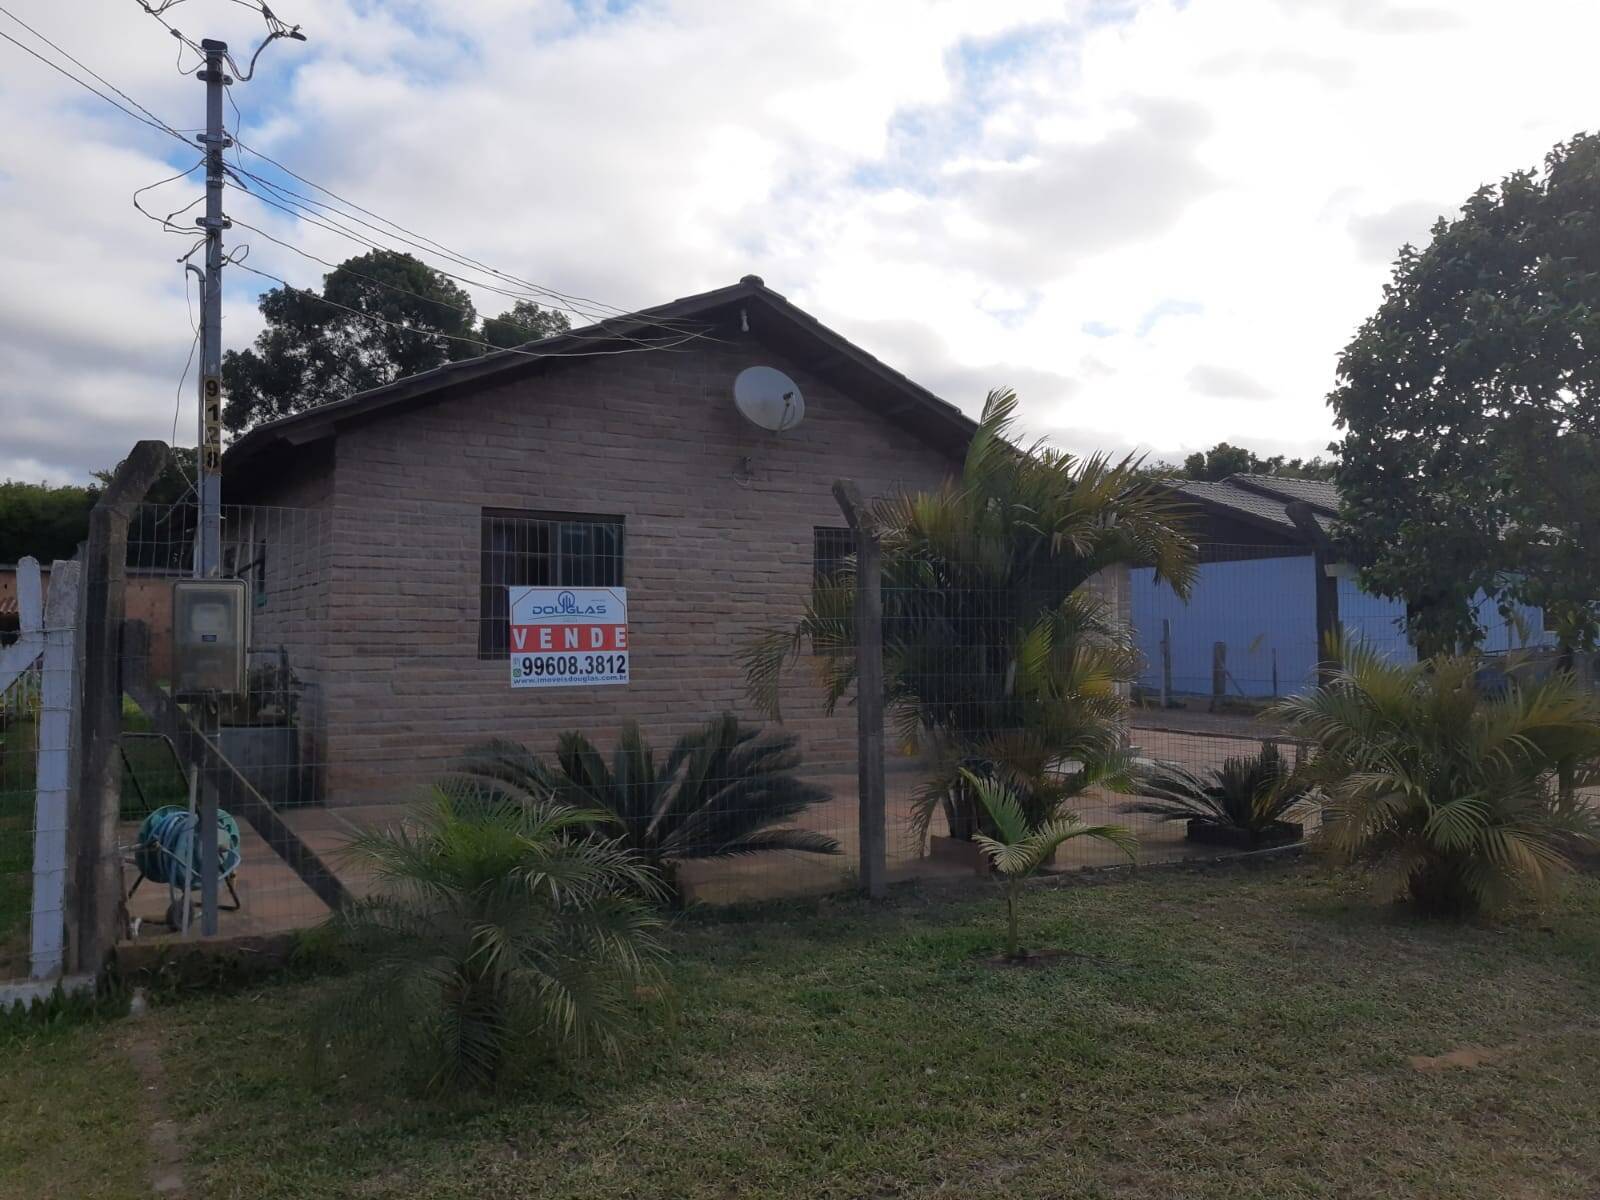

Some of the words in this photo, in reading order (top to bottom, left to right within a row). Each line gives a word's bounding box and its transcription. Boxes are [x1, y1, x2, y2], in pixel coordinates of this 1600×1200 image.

[532, 605, 607, 615] DOUGLAS
[513, 627, 627, 650] VENDE
[522, 655, 626, 676] 99608.3812
[513, 675, 627, 685] www.imoveisdouglas.com.br
